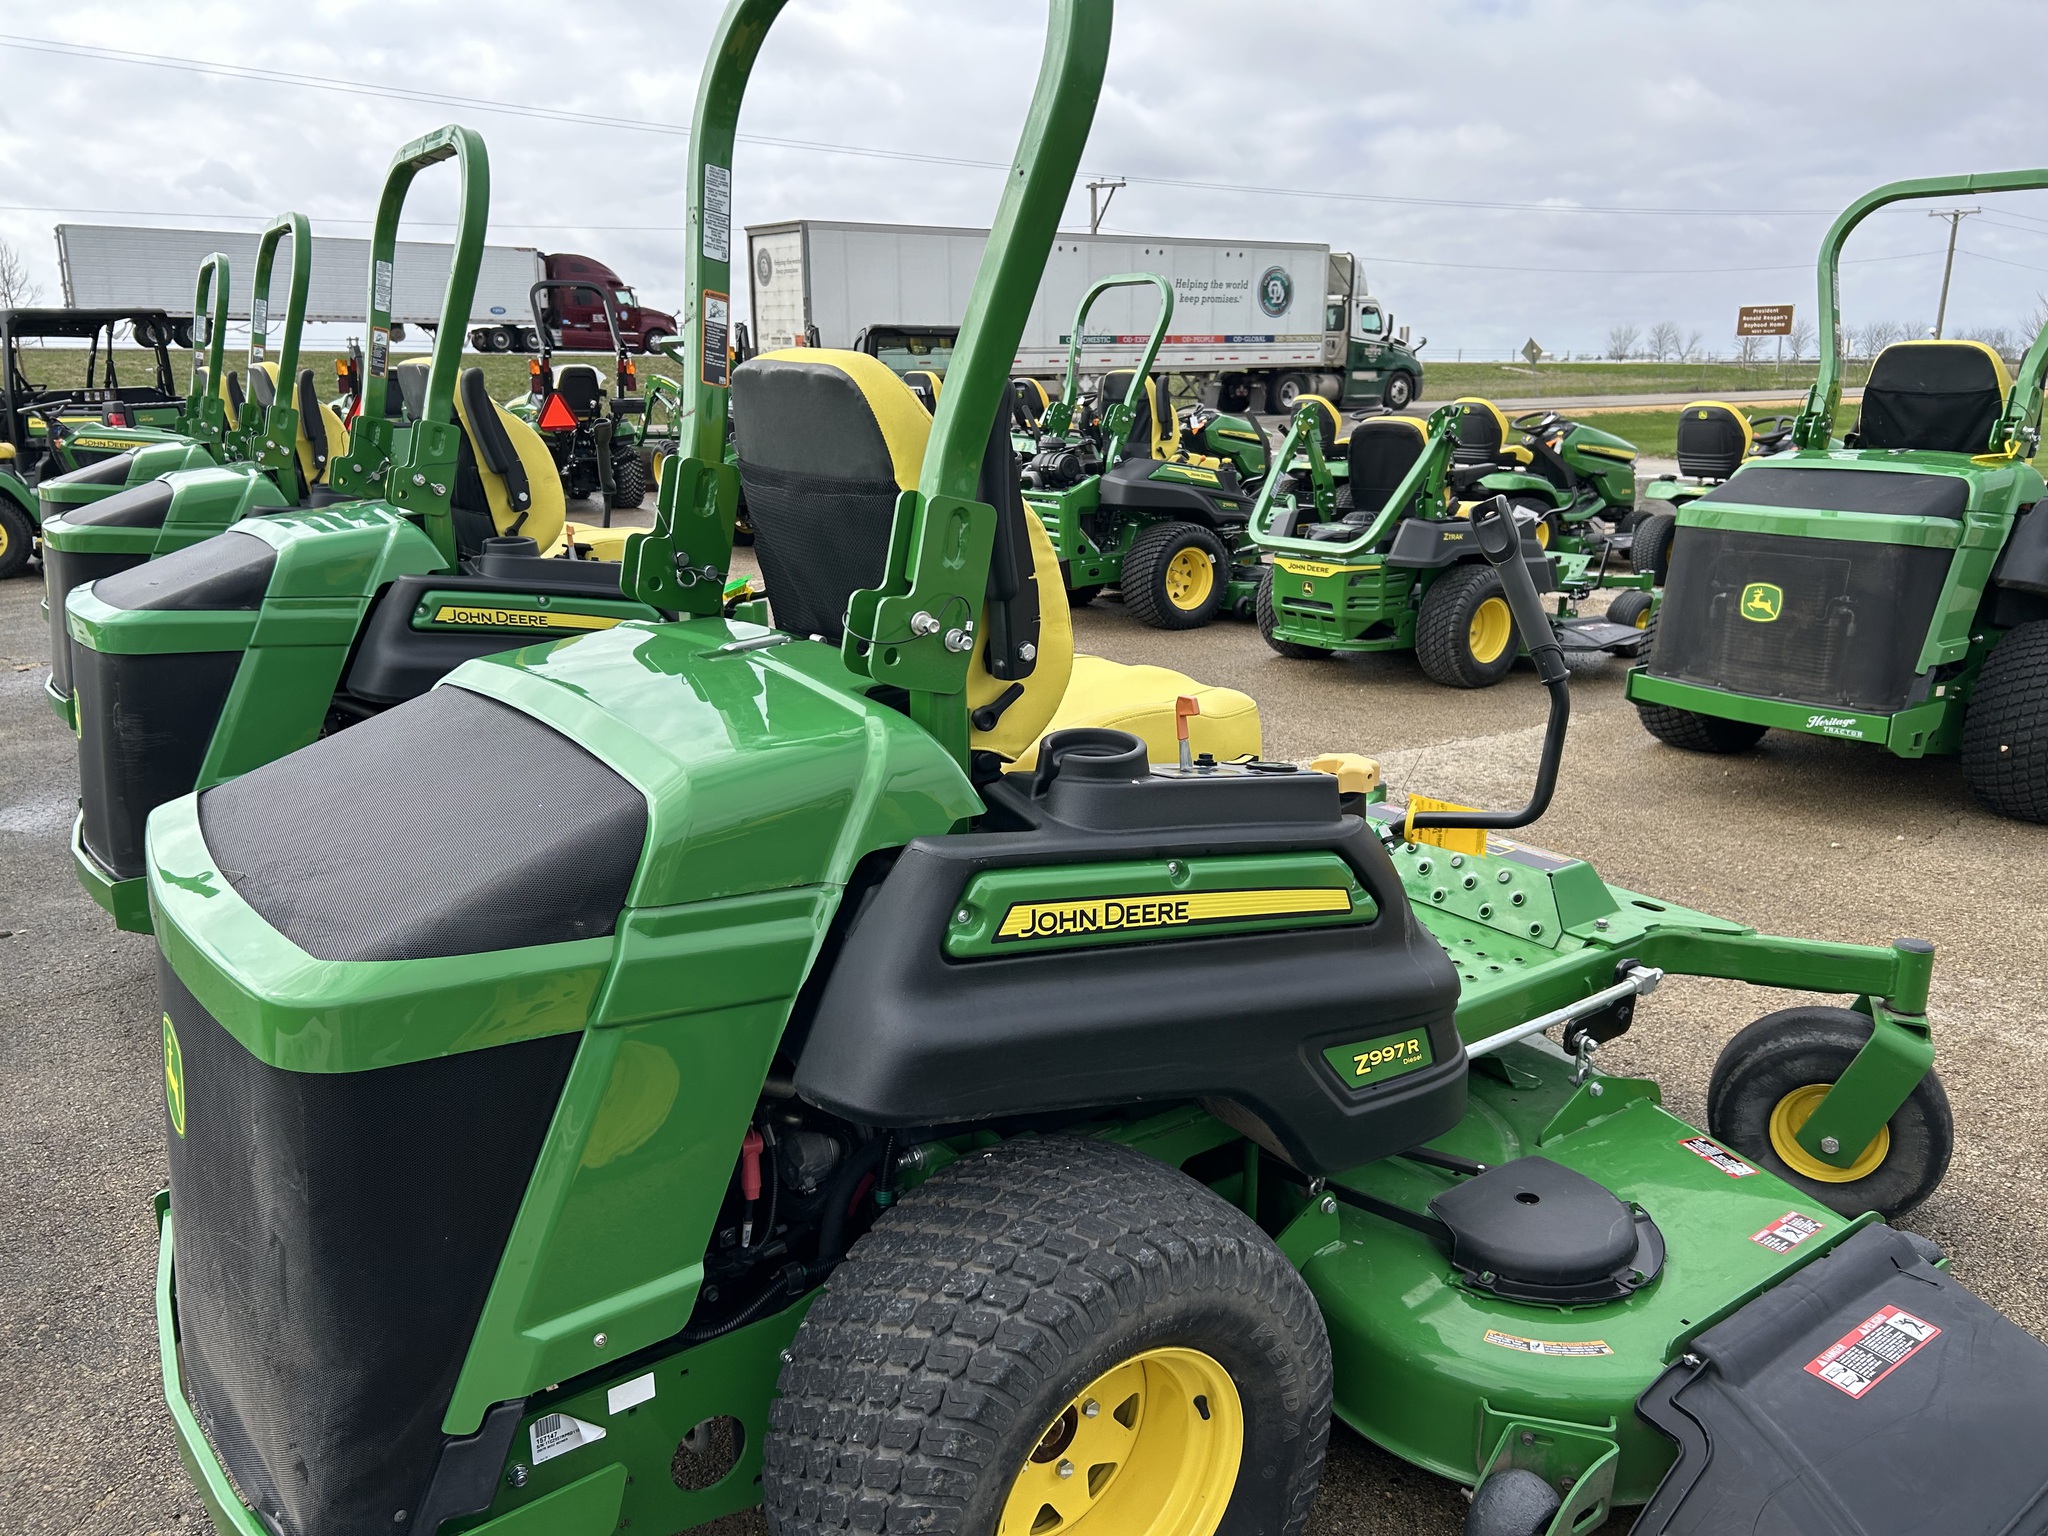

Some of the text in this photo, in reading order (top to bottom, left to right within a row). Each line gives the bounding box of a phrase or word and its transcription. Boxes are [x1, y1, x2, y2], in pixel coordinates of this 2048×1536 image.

[1175, 278, 1249, 291] Helping the world
[1179, 293, 1200, 305] keep
[82, 439, 107, 448] JOHN
[1288, 562, 1330, 574] JOHN DEERE
[447, 608, 548, 626] JOHN DEERE
[1806, 715, 1857, 728] Heritage
[1823, 726, 1863, 738] TRACTOR
[1020, 901, 1190, 935] JOHN DEERE
[1402, 1053, 1423, 1065] Diesel
[1820, 1343, 1847, 1363] DANGER
[1248, 1322, 1302, 1443] KENDA
